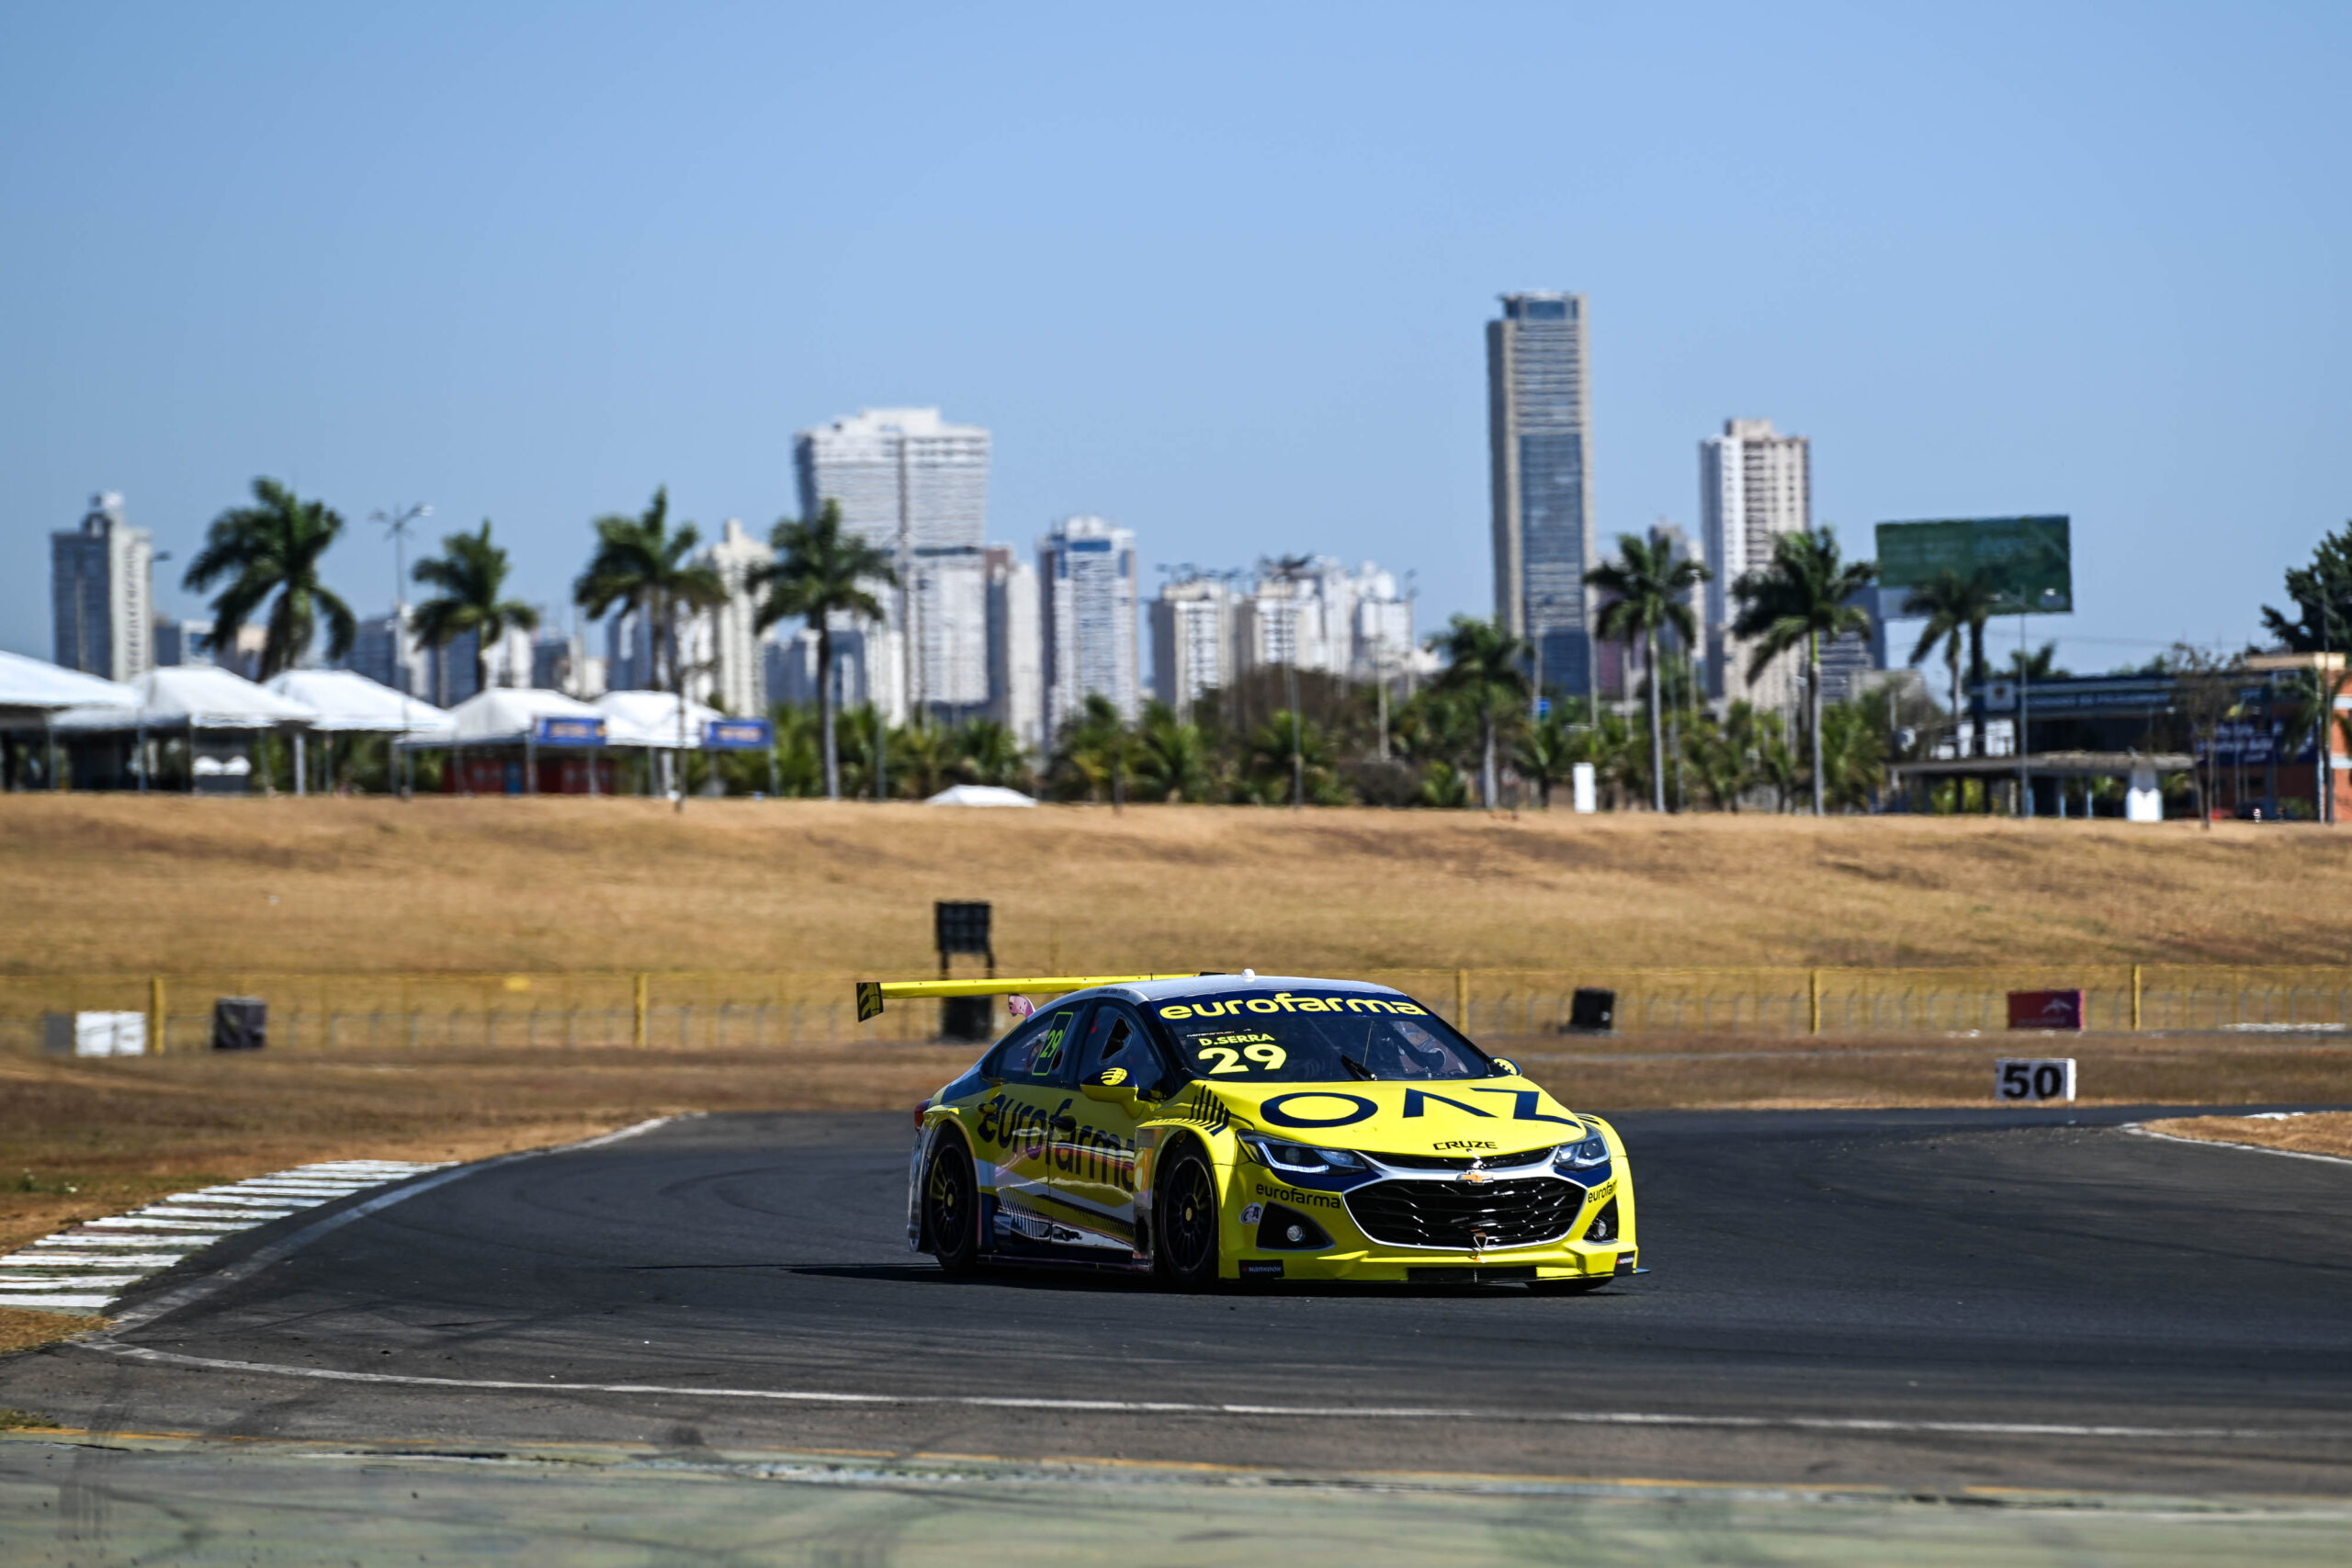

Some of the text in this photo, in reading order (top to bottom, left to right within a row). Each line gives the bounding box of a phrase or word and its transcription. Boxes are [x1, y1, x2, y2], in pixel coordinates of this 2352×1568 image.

[1159, 993, 1429, 1020] eurofarma
[1039, 1030, 1063, 1058] 29
[1198, 1033, 1275, 1046] D.SERRA
[1197, 1043, 1286, 1075] 29
[2002, 1063, 2063, 1100] 50
[1432, 1140, 1498, 1151] CRUZE
[1256, 1183, 1341, 1209] eurofarma
